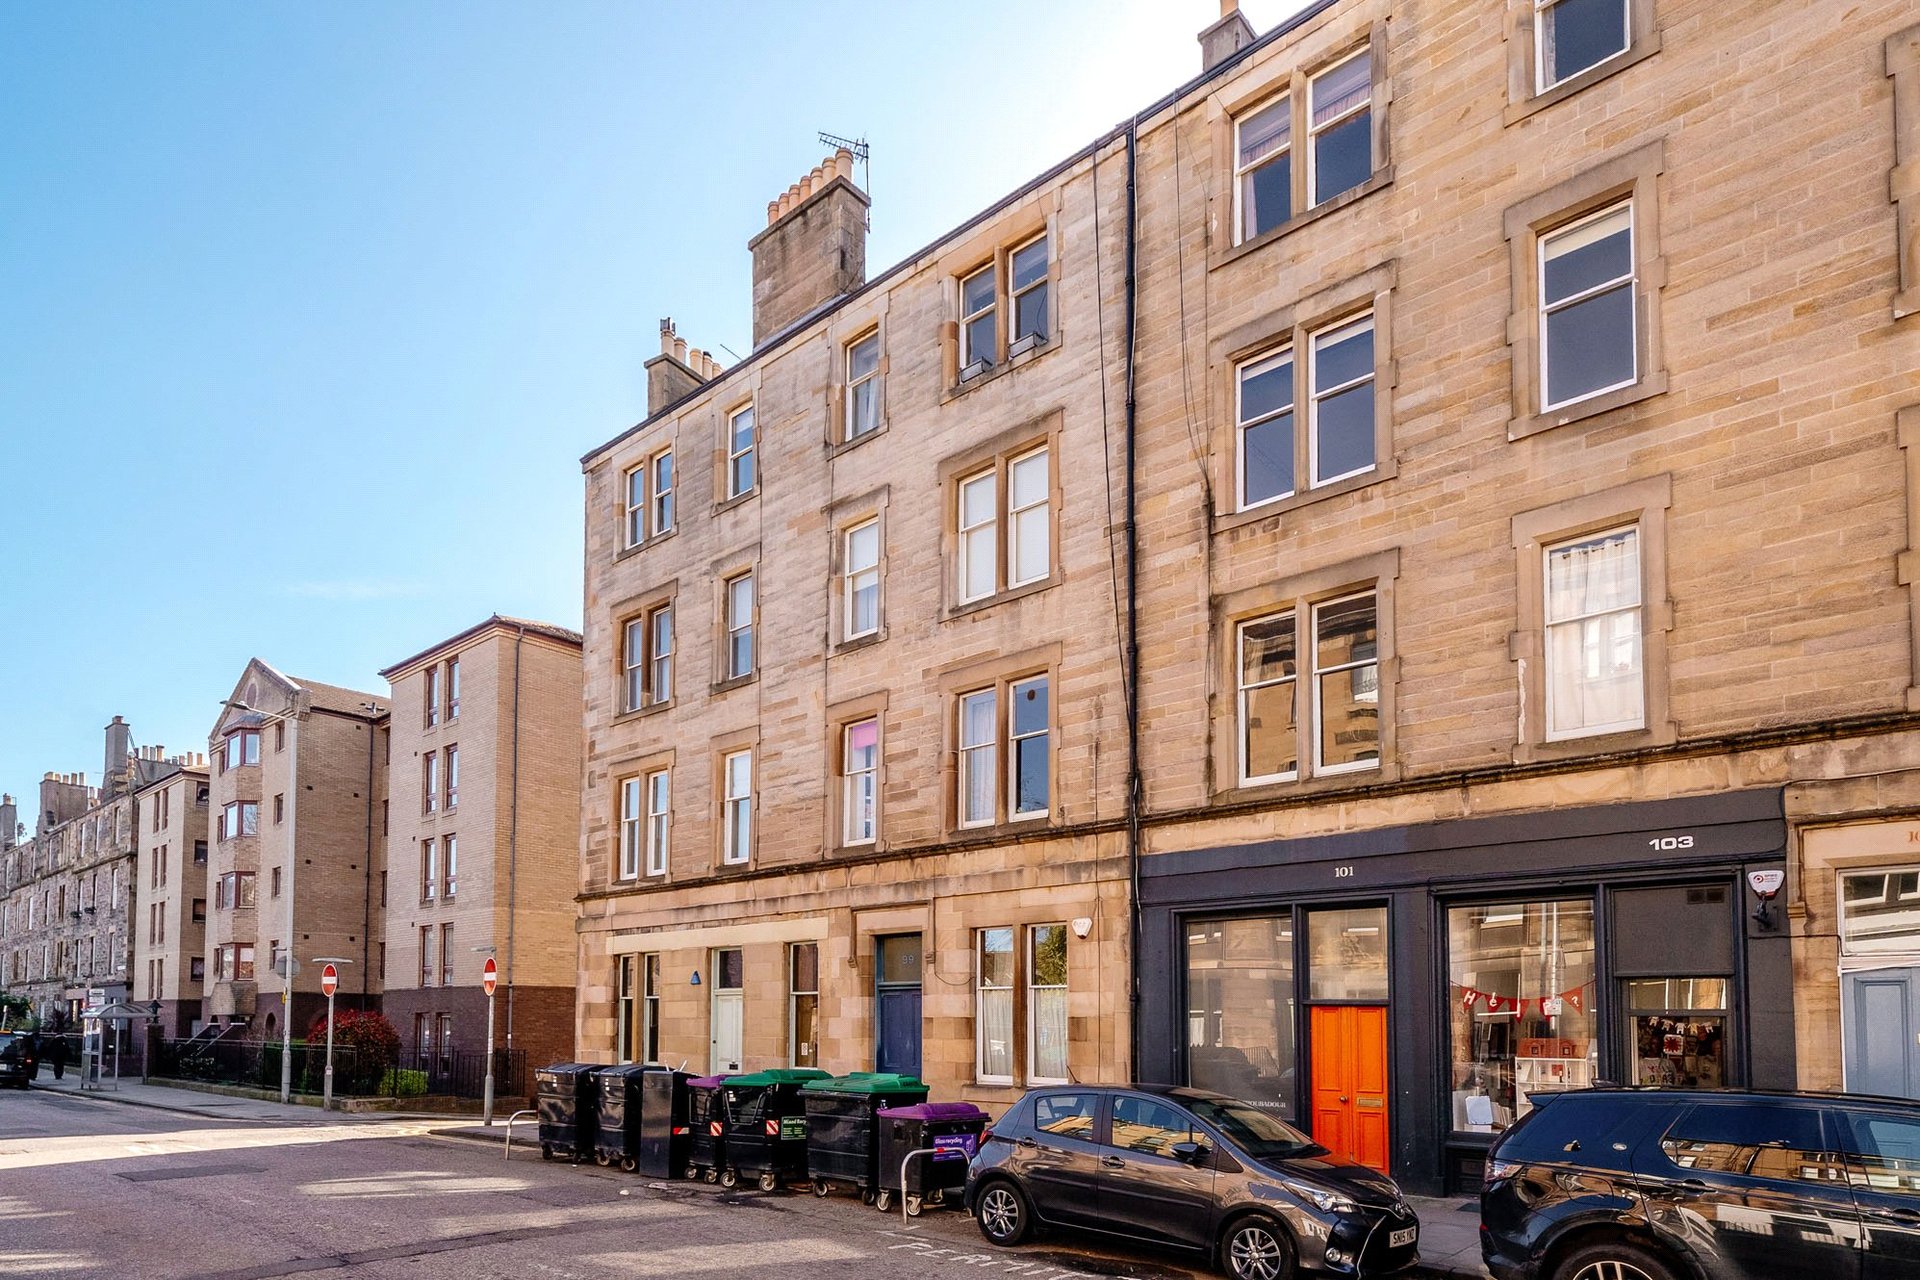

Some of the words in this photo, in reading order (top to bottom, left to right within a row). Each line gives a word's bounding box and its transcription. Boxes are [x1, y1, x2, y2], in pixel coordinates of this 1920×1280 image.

[1649, 836, 1694, 850] 103
[1335, 866, 1354, 877] 101
[797, 1118, 808, 1126] Recy
